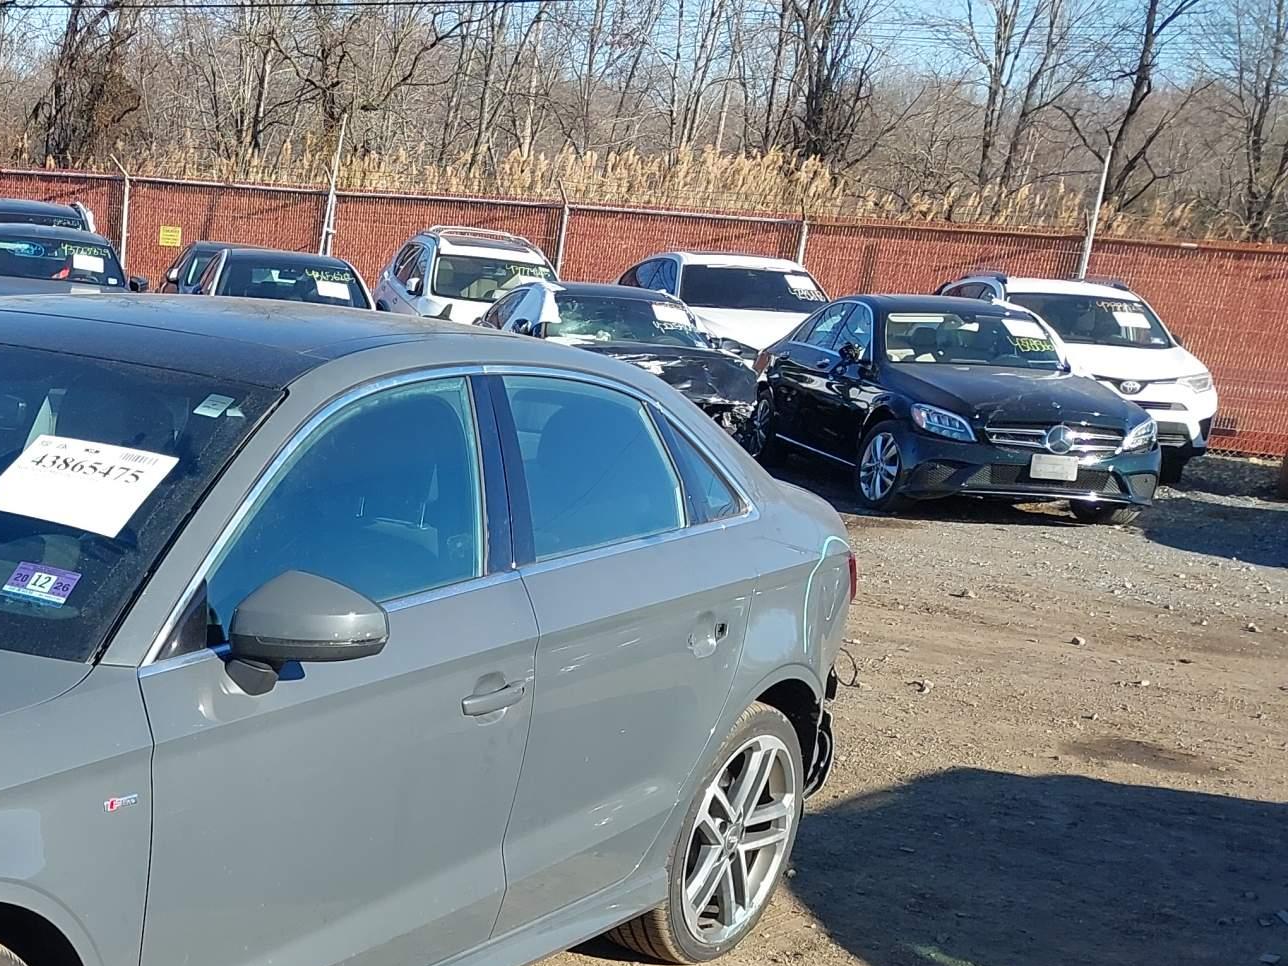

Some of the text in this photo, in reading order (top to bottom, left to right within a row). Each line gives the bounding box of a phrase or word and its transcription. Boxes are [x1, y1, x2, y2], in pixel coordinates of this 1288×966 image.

[31, 453, 144, 484] 43865475
[31, 574, 52, 589] 12
[53, 582, 71, 592] 26
